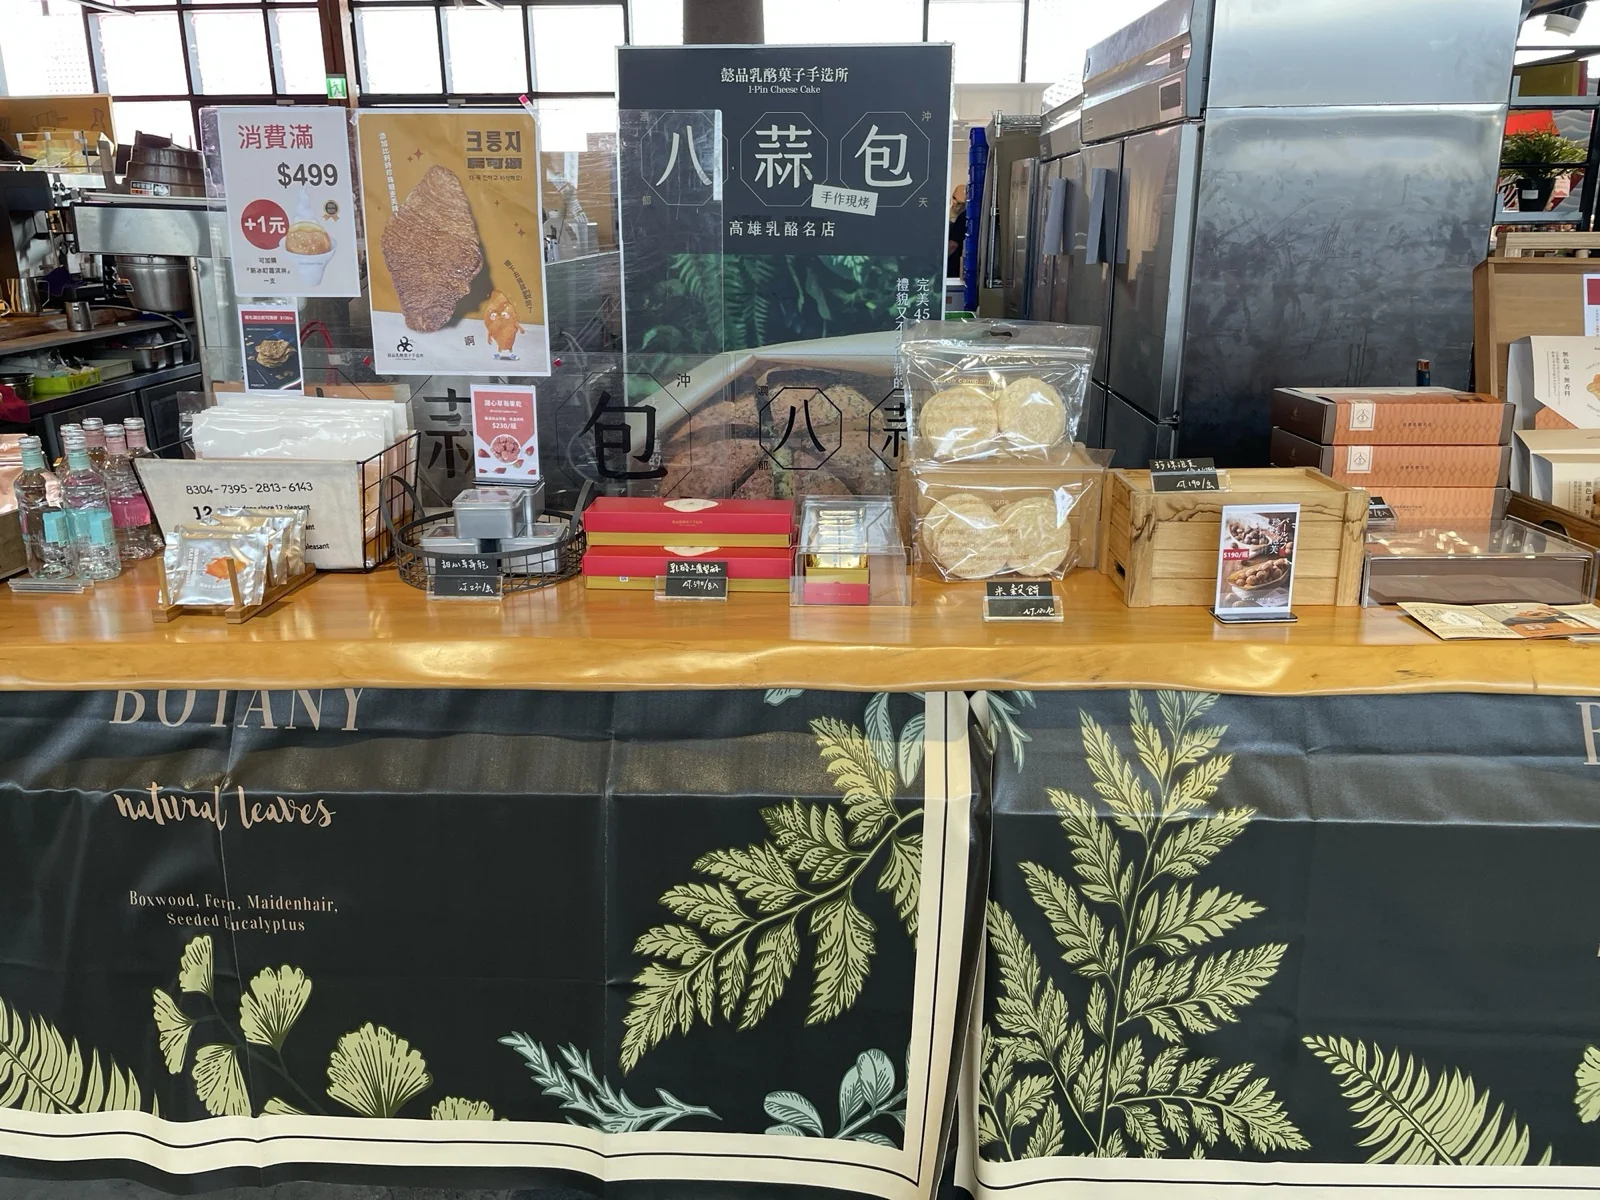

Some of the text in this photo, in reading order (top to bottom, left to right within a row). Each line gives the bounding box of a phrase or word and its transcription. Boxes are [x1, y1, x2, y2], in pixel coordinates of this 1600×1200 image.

[720, 67, 849, 83] 懿品乳酪菓子手造所
[748, 85, 821, 94] I-Pin Cheese Cake
[238, 124, 314, 149] 消費滿
[466, 131, 521, 152] 크룽지
[277, 162, 338, 188] $499
[821, 191, 870, 209] 手作現烤
[244, 215, 287, 235] +1元
[729, 221, 836, 237] 高雄乳酪名店
[677, 373, 690, 387] 沖
[579, 390, 668, 479] 包
[772, 400, 827, 452] 八
[113, 781, 337, 831] natural leaves
[129, 890, 338, 914] Boxwood, Fern, Maidenhair,
[166, 912, 220, 928] Seeded
